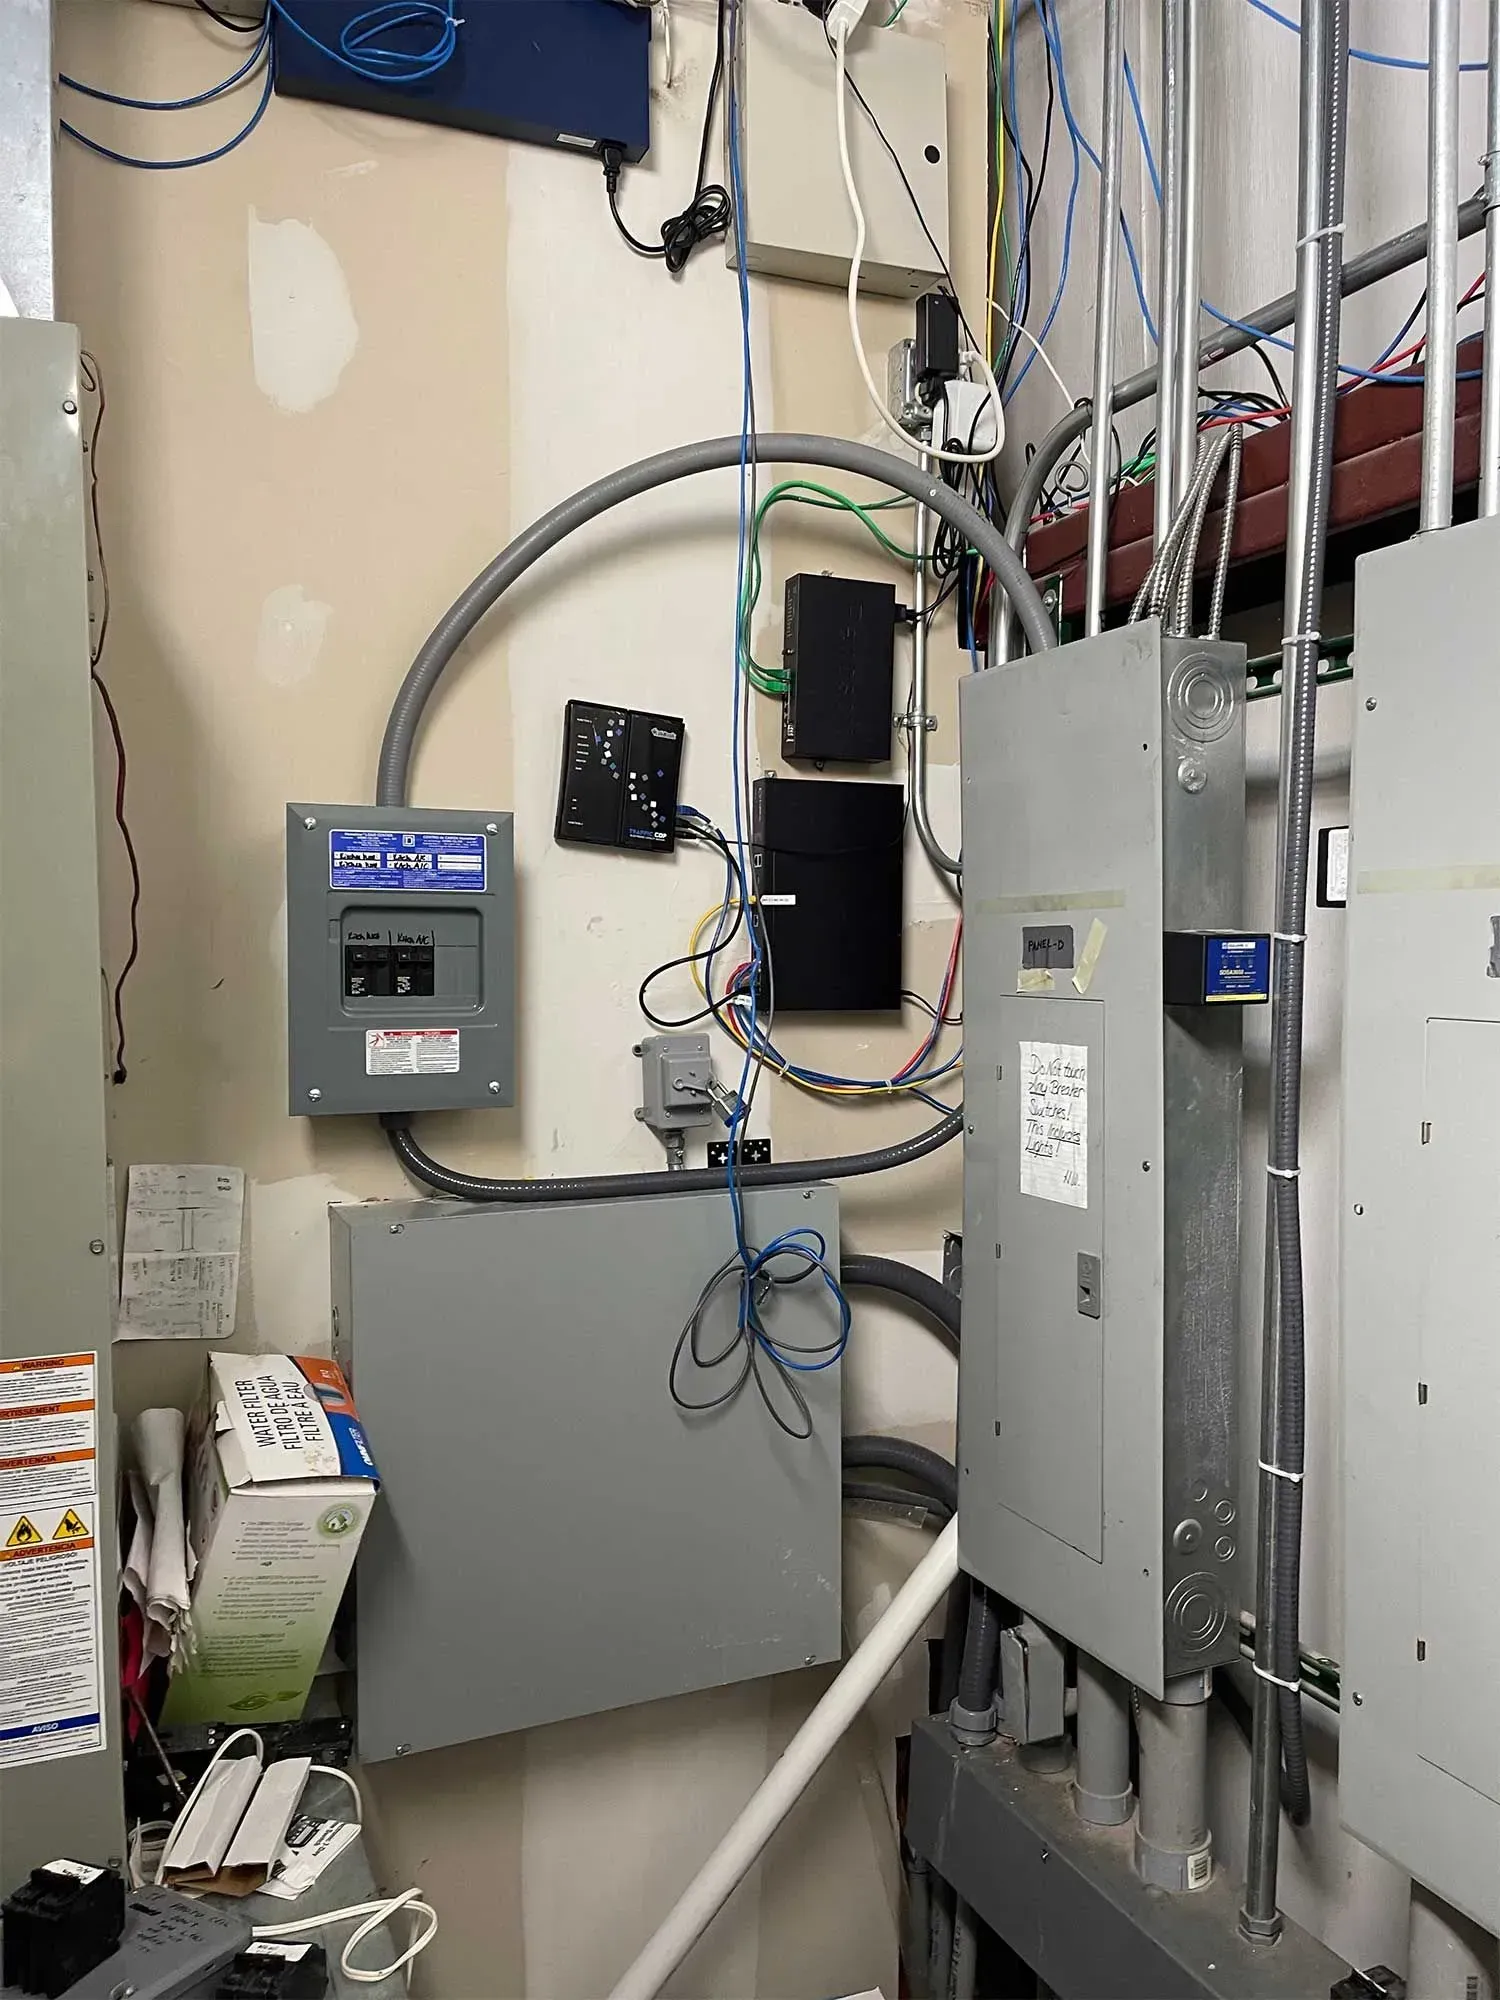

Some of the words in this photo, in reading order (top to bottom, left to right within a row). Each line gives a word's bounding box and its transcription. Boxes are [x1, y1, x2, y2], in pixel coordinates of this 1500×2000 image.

[1028, 938, 1065, 952] PANEL-D
[1063, 1062, 1086, 1081] touch
[1026, 1118, 1044, 1136] This
[21, 1358, 65, 1369] WARNING
[235, 1380, 262, 1409] FILTER
[257, 1375, 282, 1399] AGUA
[282, 1382, 305, 1399] EAU
[267, 1402, 288, 1417] DE
[247, 1411, 276, 1447] WATER
[274, 1418, 303, 1450] FILTRO
[294, 1411, 324, 1442] FILTRE
[13, 1542, 76, 1557] ADVERTENCIA
[31, 1722, 59, 1734] AVISO
